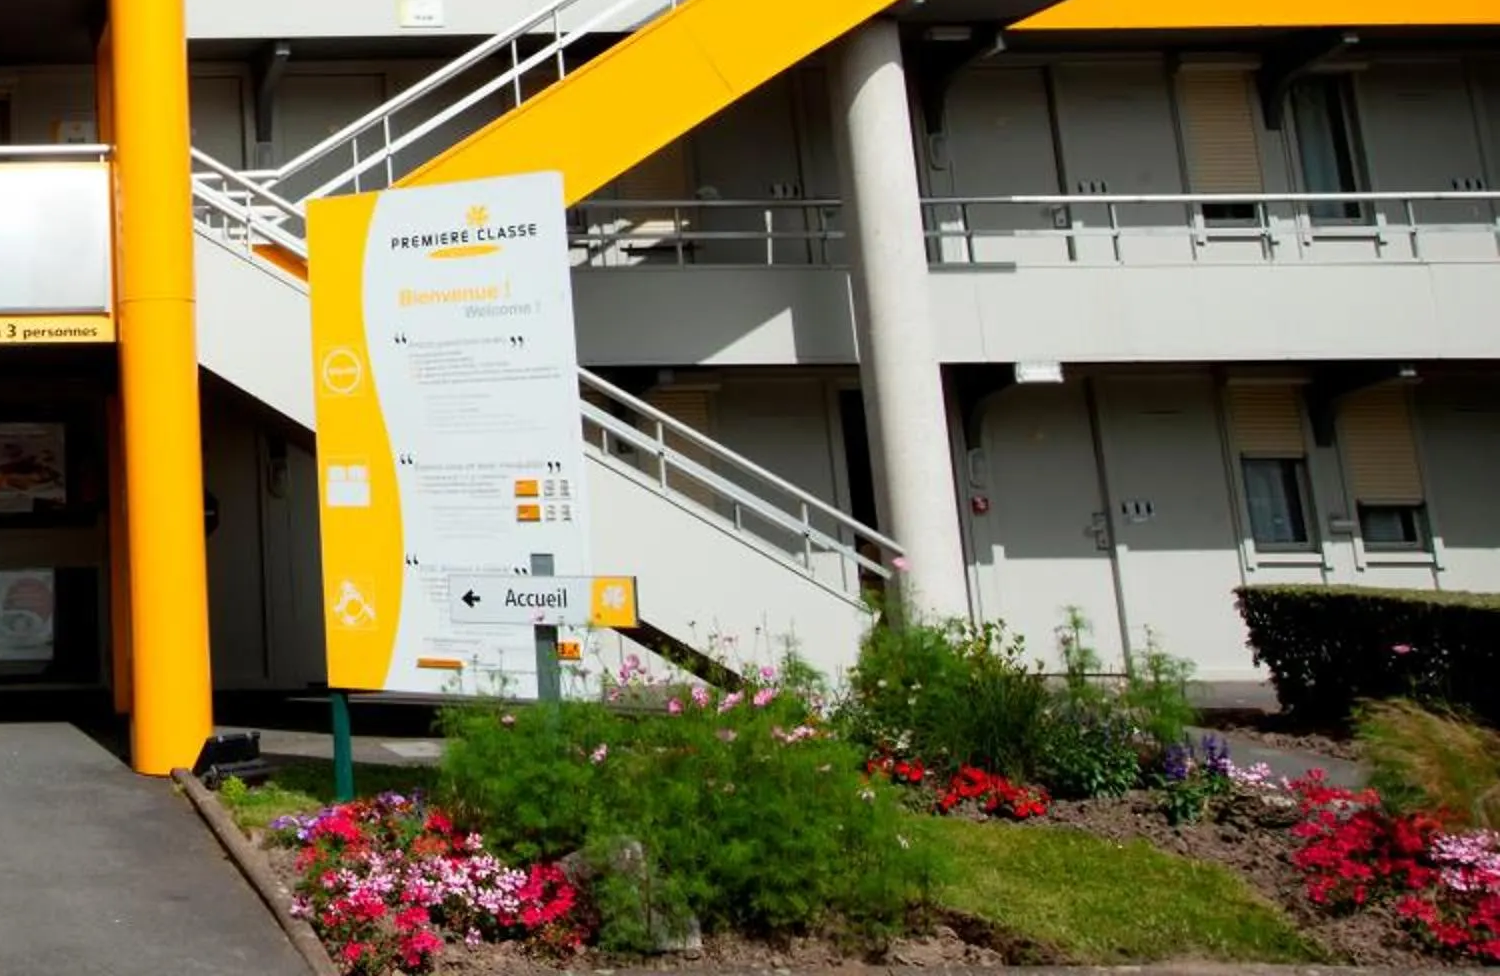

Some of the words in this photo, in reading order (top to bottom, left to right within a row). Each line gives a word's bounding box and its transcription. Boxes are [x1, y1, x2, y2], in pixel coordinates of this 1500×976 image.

[390, 229, 469, 250] PREMIERE
[476, 223, 537, 241] CLASSE
[6, 324, 17, 338] 3
[23, 327, 98, 341] personnes
[505, 588, 568, 609] Accueil
